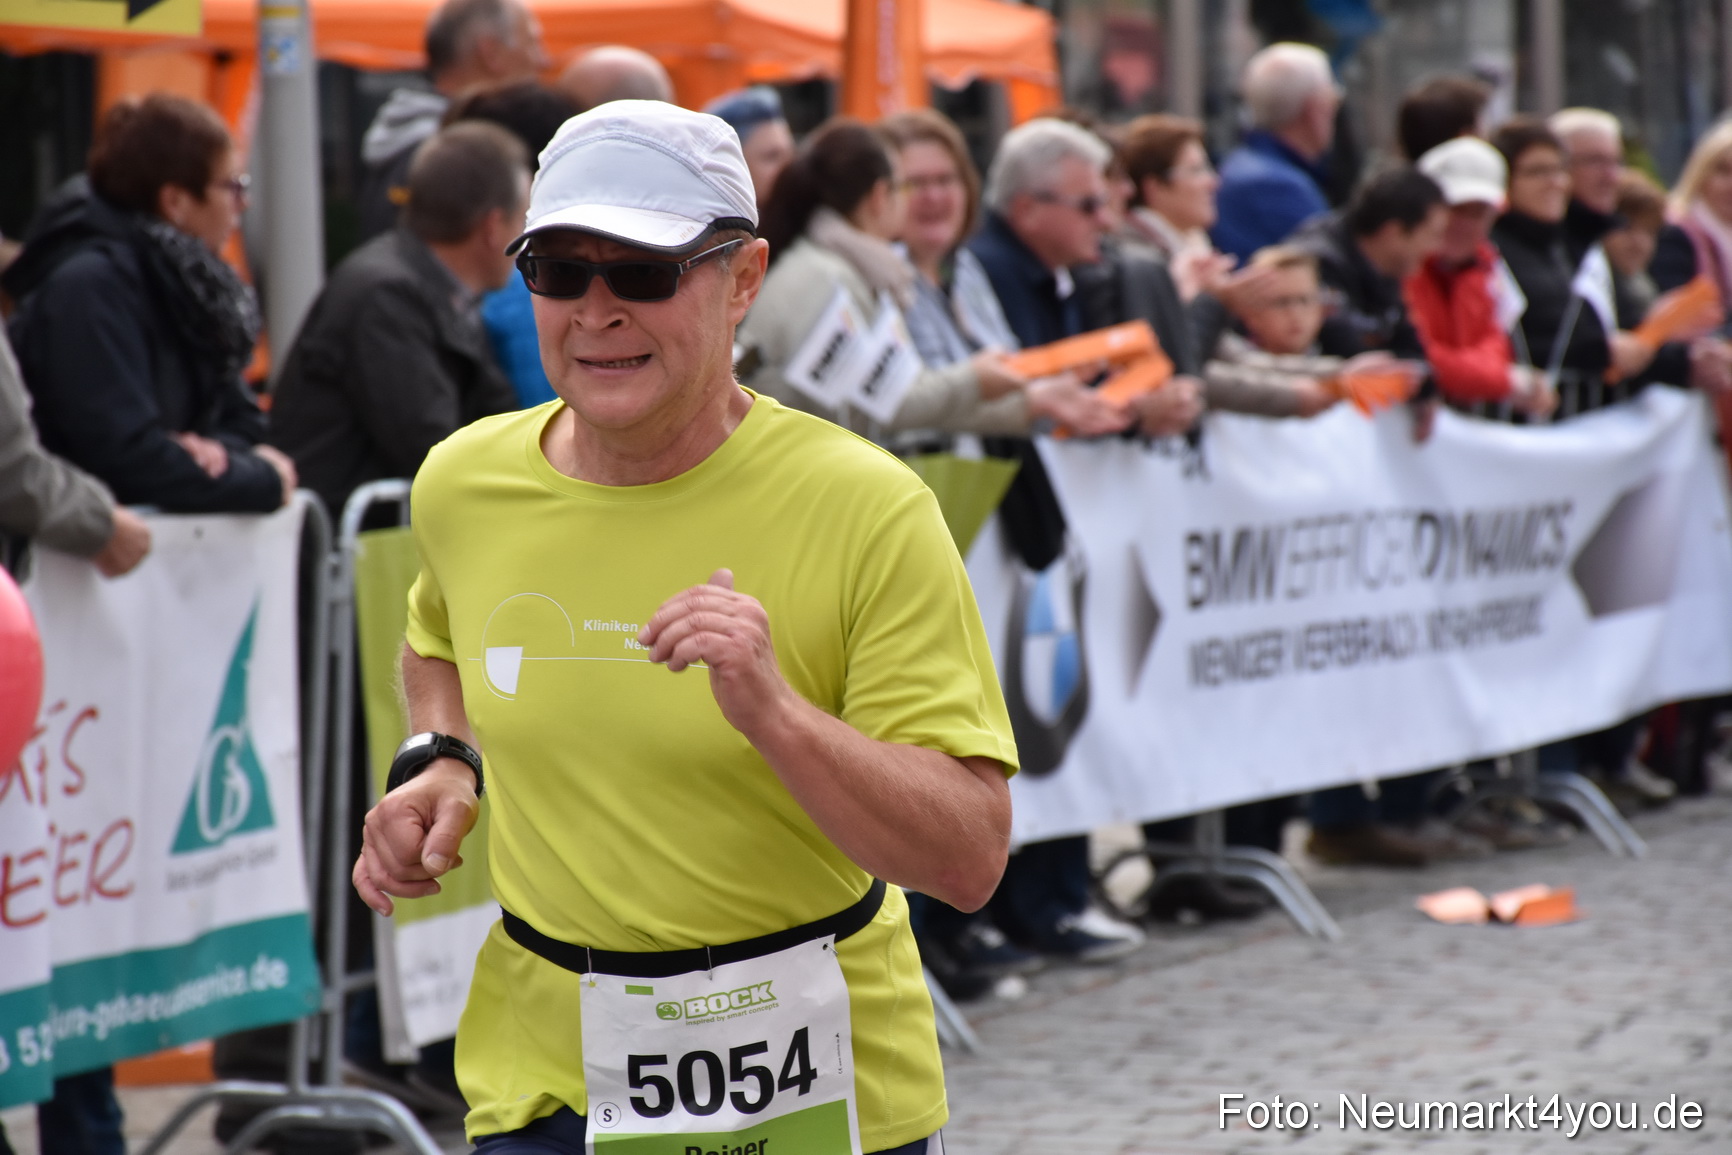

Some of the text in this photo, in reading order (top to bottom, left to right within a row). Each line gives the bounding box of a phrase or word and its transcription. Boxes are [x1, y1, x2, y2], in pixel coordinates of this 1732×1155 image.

[583, 619, 638, 632] Kliniken
[684, 980, 777, 1019] BOCK
[685, 1002, 780, 1026] inspired by smart concepts
[627, 1026, 818, 1119] 5054
[603, 1108, 613, 1123] S
